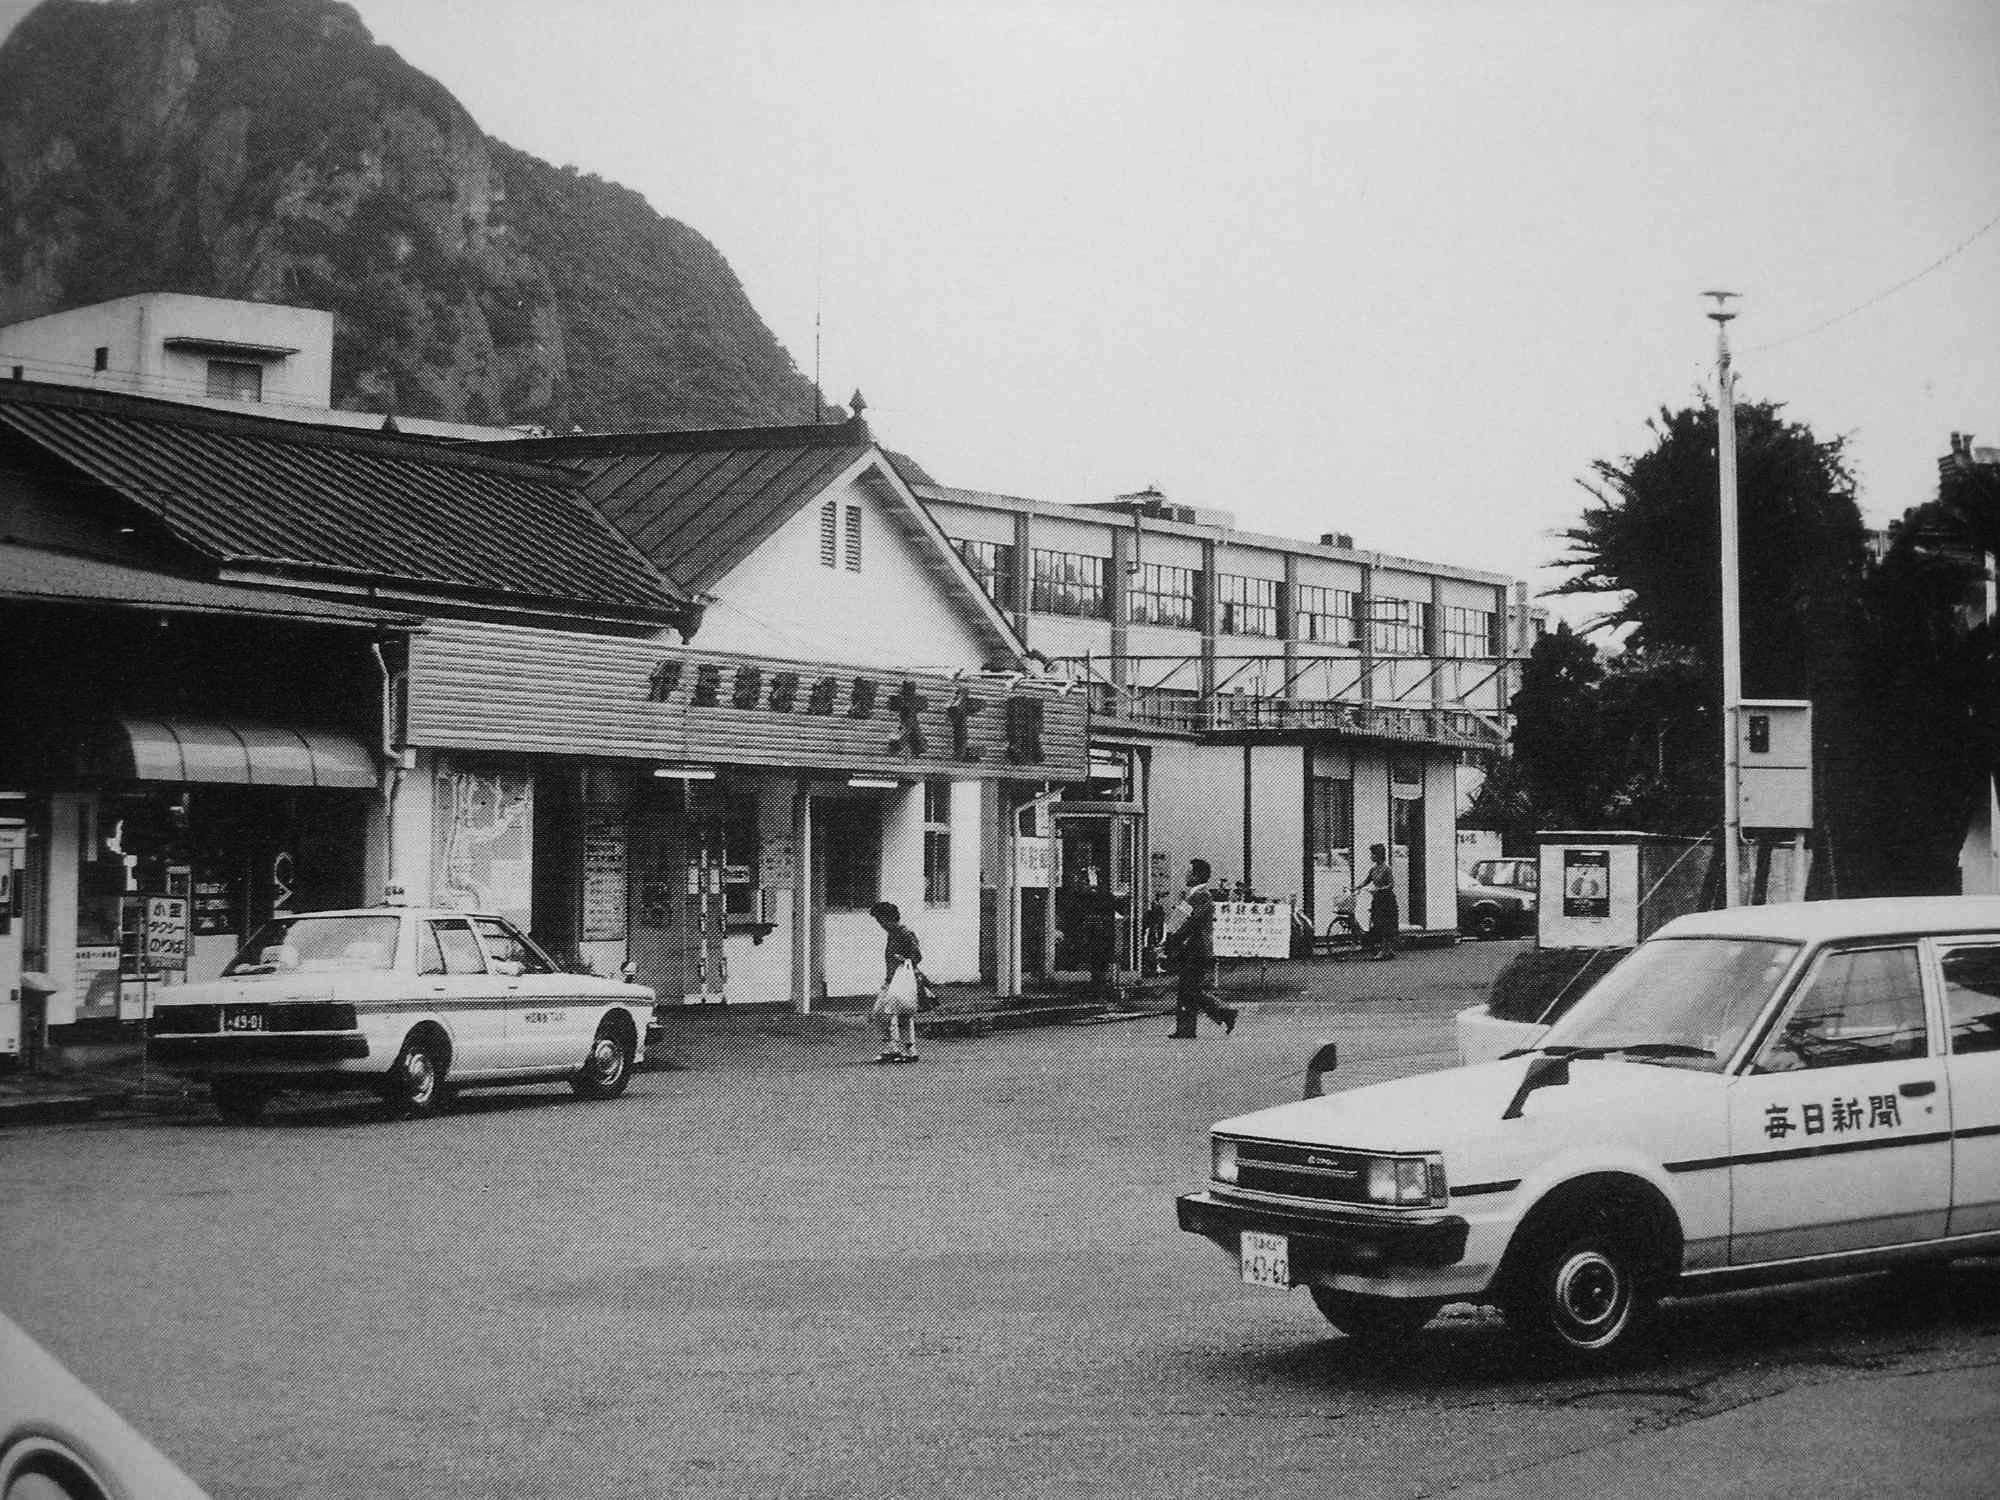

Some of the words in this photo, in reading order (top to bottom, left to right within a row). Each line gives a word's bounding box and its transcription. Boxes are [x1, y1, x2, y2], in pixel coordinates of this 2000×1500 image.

[148, 921, 185, 935] タクシー
[1764, 1094, 1902, 1139] 毎日新聞
